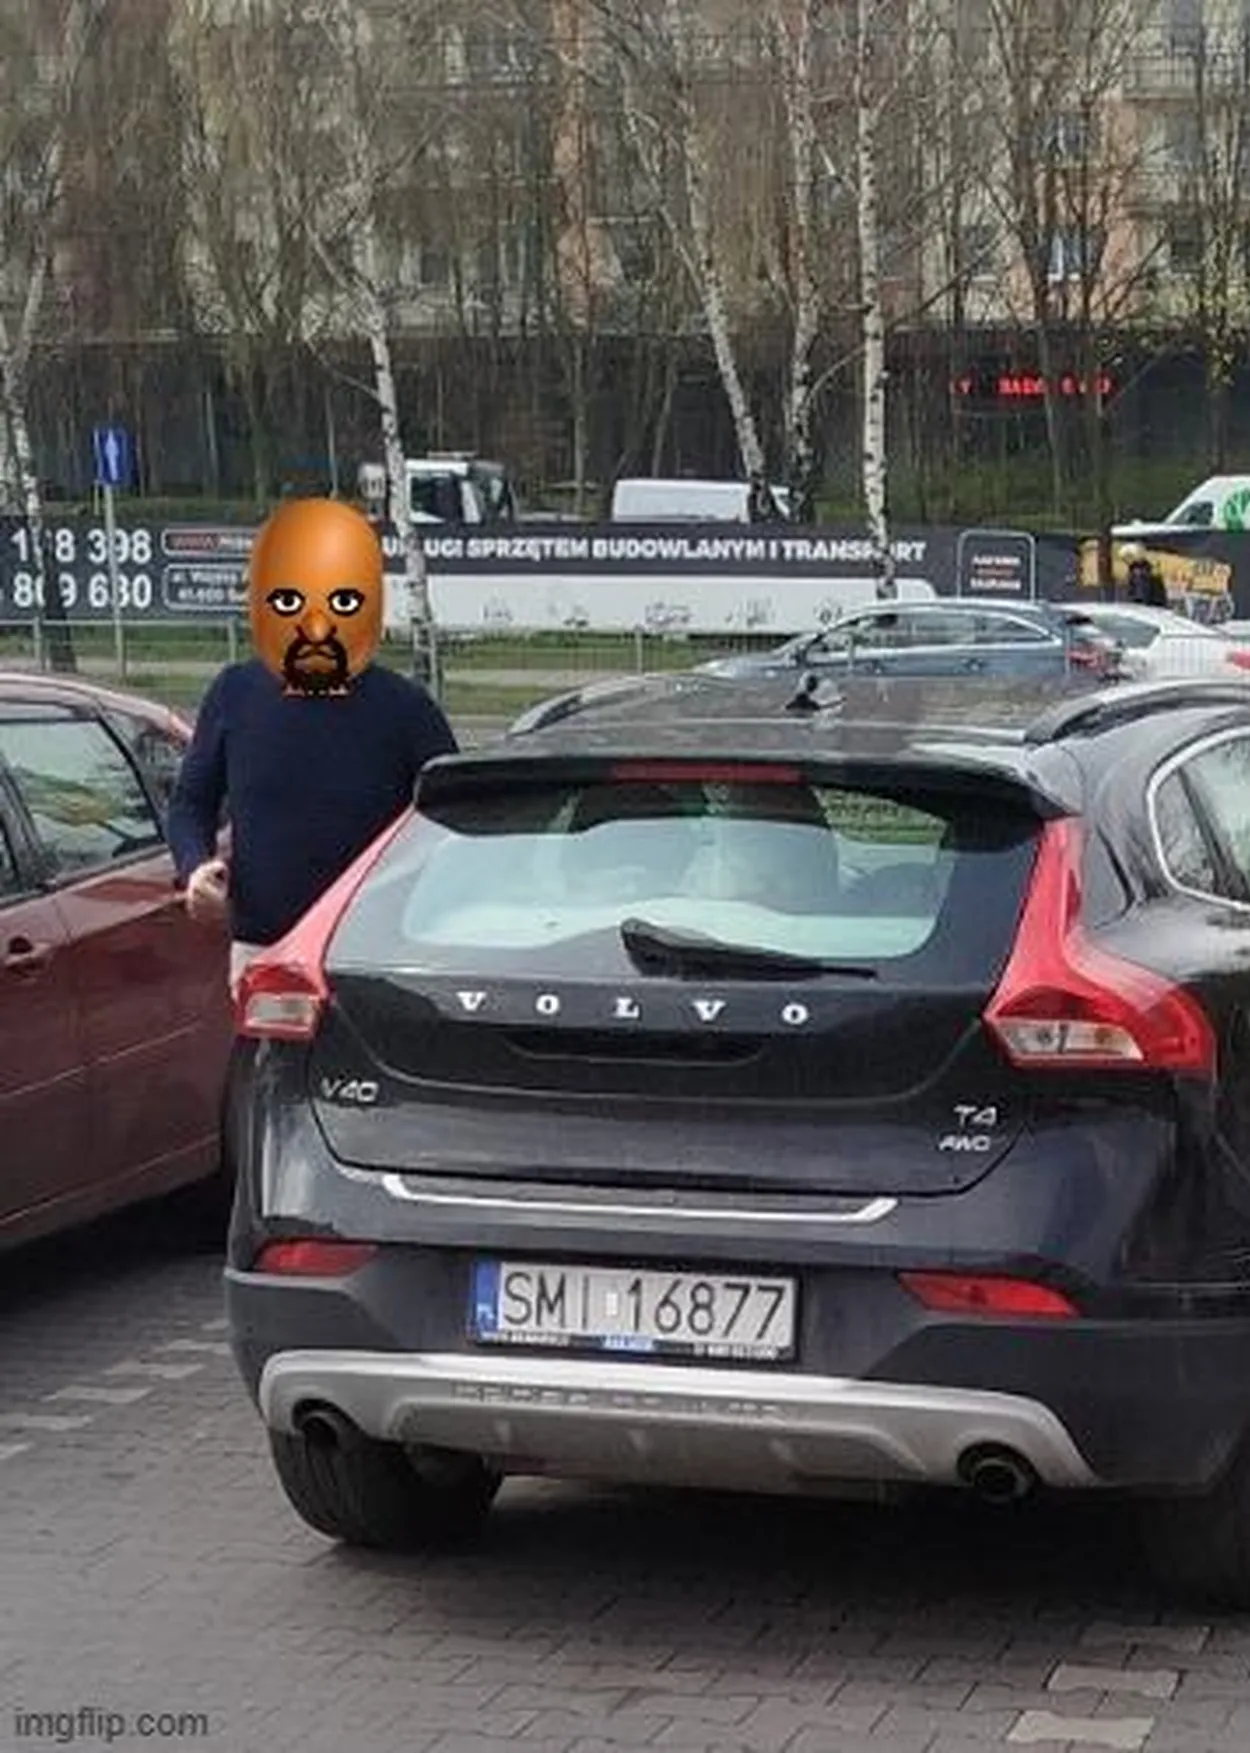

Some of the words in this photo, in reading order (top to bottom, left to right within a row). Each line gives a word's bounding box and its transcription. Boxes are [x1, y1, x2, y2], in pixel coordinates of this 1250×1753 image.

[10, 527, 76, 563] 18
[382, 536, 463, 558] UUGI
[456, 990, 811, 1027] VOLVO
[321, 1077, 380, 1103] V40
[952, 1104, 998, 1128] T4
[627, 1276, 787, 1340] 16877
